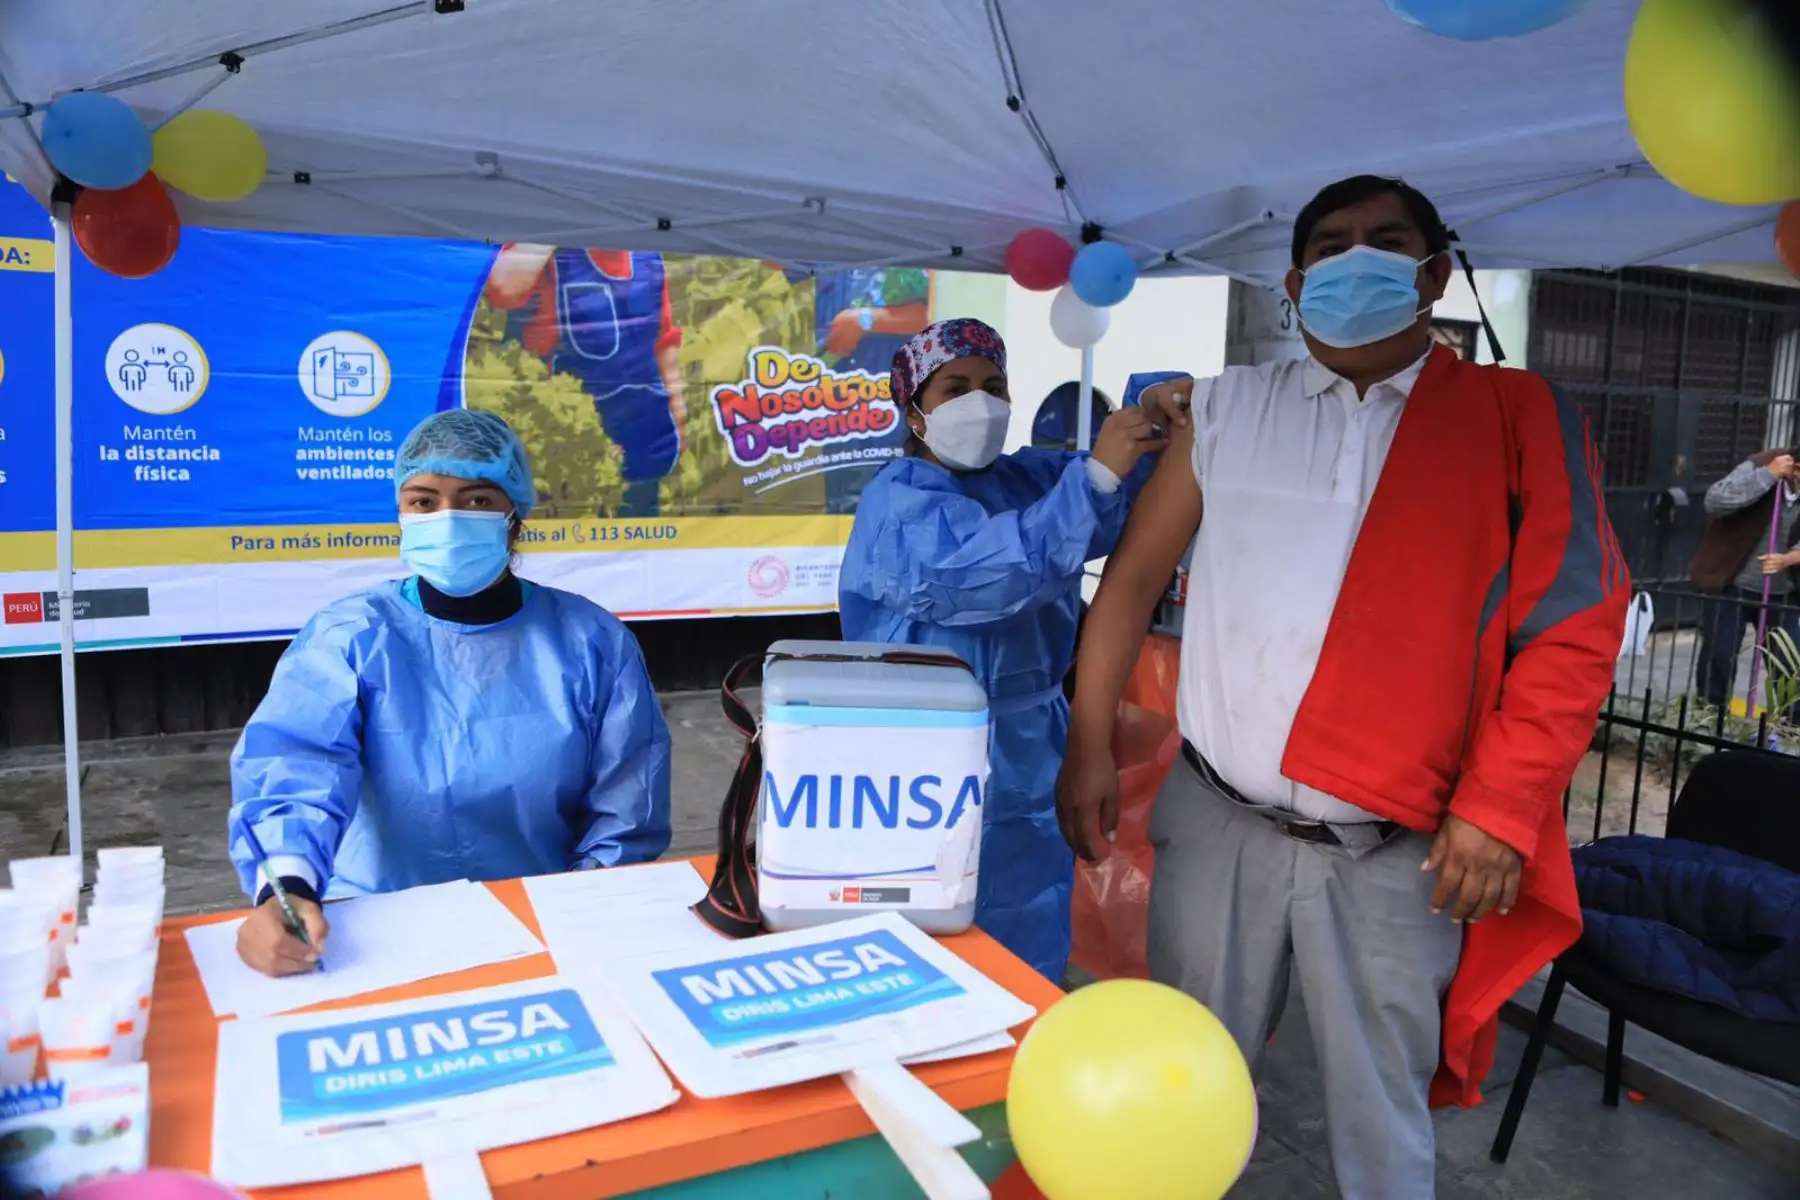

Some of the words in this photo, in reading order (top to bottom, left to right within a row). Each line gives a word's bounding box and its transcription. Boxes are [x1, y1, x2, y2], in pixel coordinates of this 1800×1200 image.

[755, 351, 821, 387] De
[716, 374, 892, 430] Nosotros
[124, 425, 197, 441] Mantén
[298, 426, 364, 441] Mantén
[368, 426, 392, 442] los
[731, 402, 895, 462] Depende
[99, 445, 120, 461] la
[125, 445, 221, 461] distancia
[296, 446, 395, 461] ambientes
[793, 454, 830, 472] guardia
[134, 465, 190, 481] física
[296, 465, 395, 480] ventilados
[231, 535, 275, 550] Para
[281, 532, 321, 549] más
[327, 532, 401, 548] informa
[551, 527, 566, 541] al
[590, 526, 619, 541] 113
[624, 525, 678, 541] SALUD
[8, 600, 39, 614] PERÚ
[763, 770, 982, 830] MINSA
[680, 942, 907, 1006] MINSA
[721, 999, 790, 1022] DIRIS
[793, 985, 855, 1008] LIMA
[856, 971, 916, 994] ESTE
[307, 1002, 570, 1073] MINSA
[324, 1067, 408, 1093] DIRIS
[414, 1054, 489, 1080] LIMA
[493, 1039, 566, 1064] ESTE
